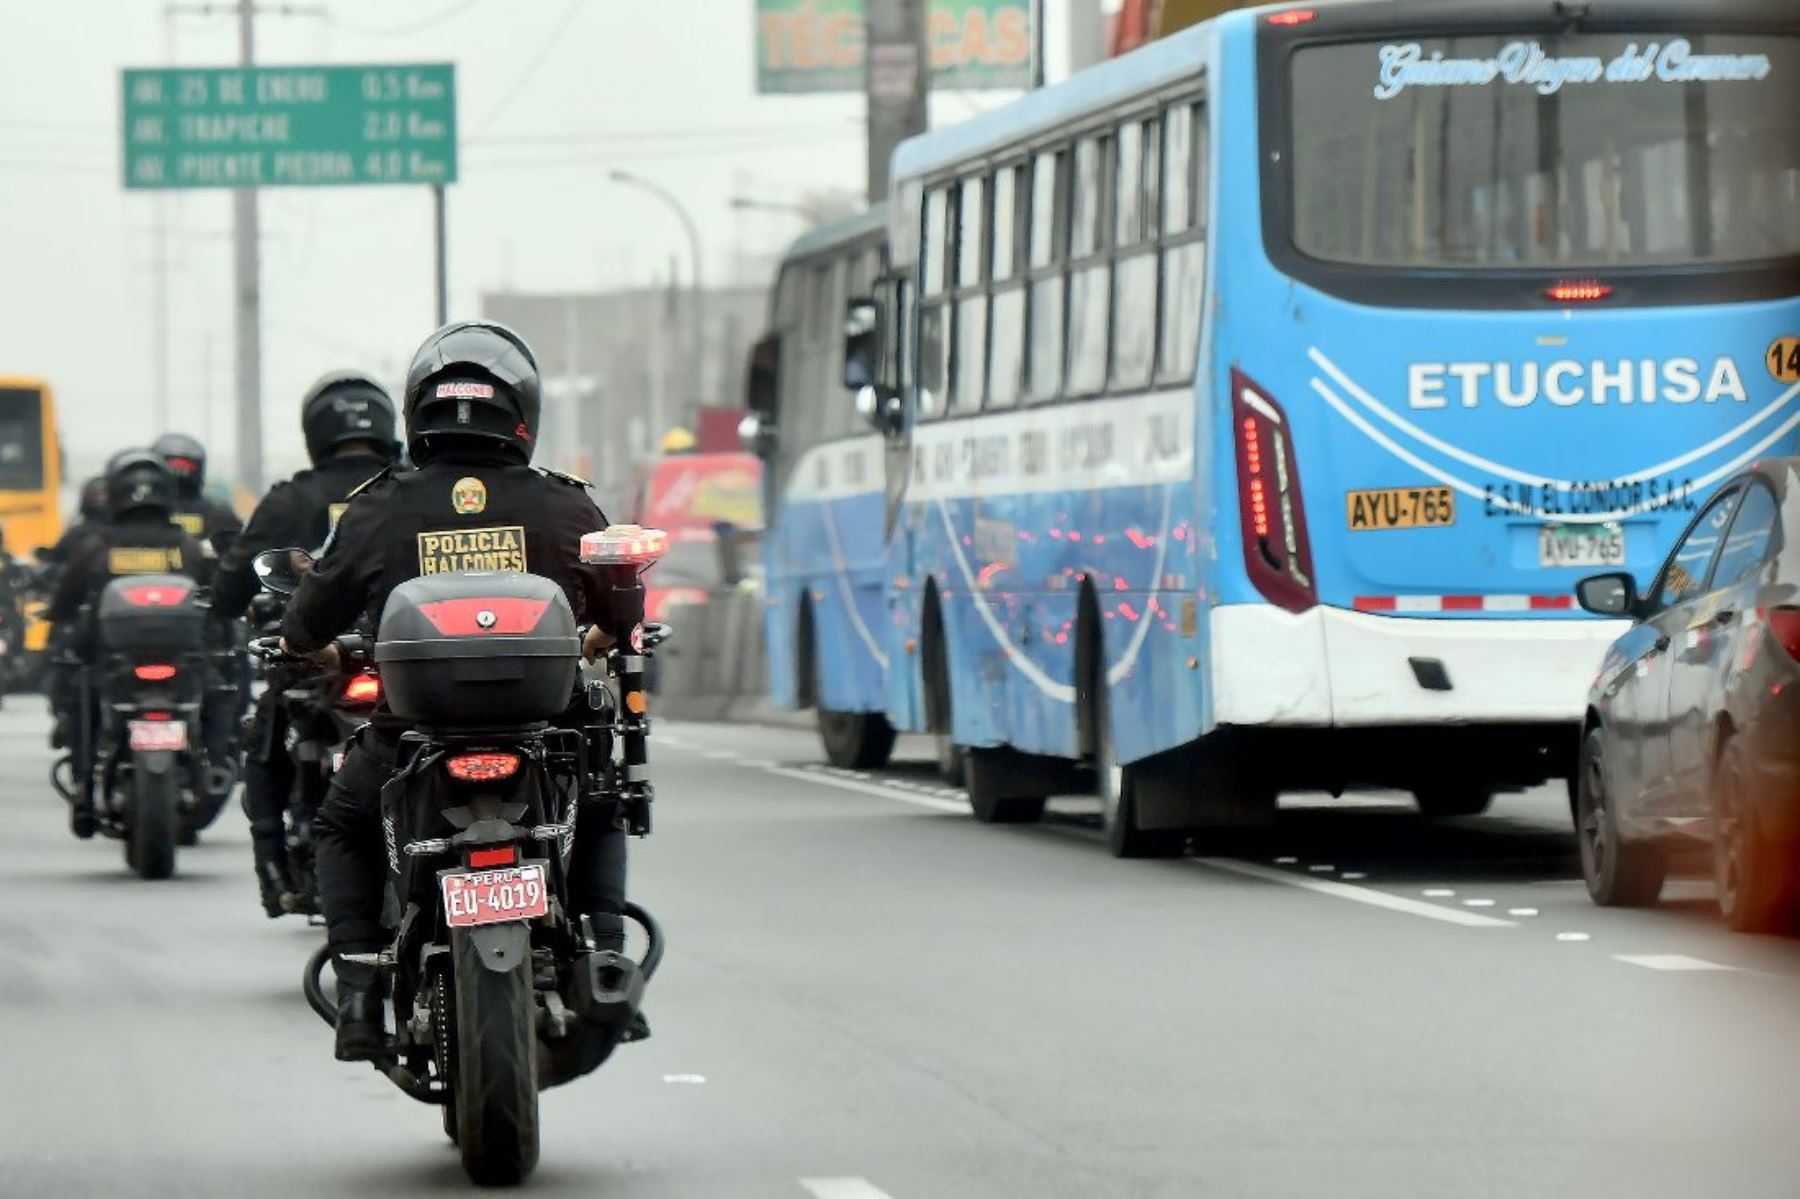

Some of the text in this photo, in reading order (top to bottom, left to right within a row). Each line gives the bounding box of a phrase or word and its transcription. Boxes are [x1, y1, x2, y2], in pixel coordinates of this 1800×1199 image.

[1605, 42, 1660, 81] del
[218, 74, 246, 103] DE
[256, 72, 328, 103] ENERO
[177, 153, 263, 181] PUENTE
[1408, 357, 1748, 409] ETUCHISA
[1352, 489, 1452, 527] AYU-765
[425, 532, 518, 555] POLICIA
[424, 553, 523, 575] HALCONES
[449, 882, 539, 917] EU-4019
